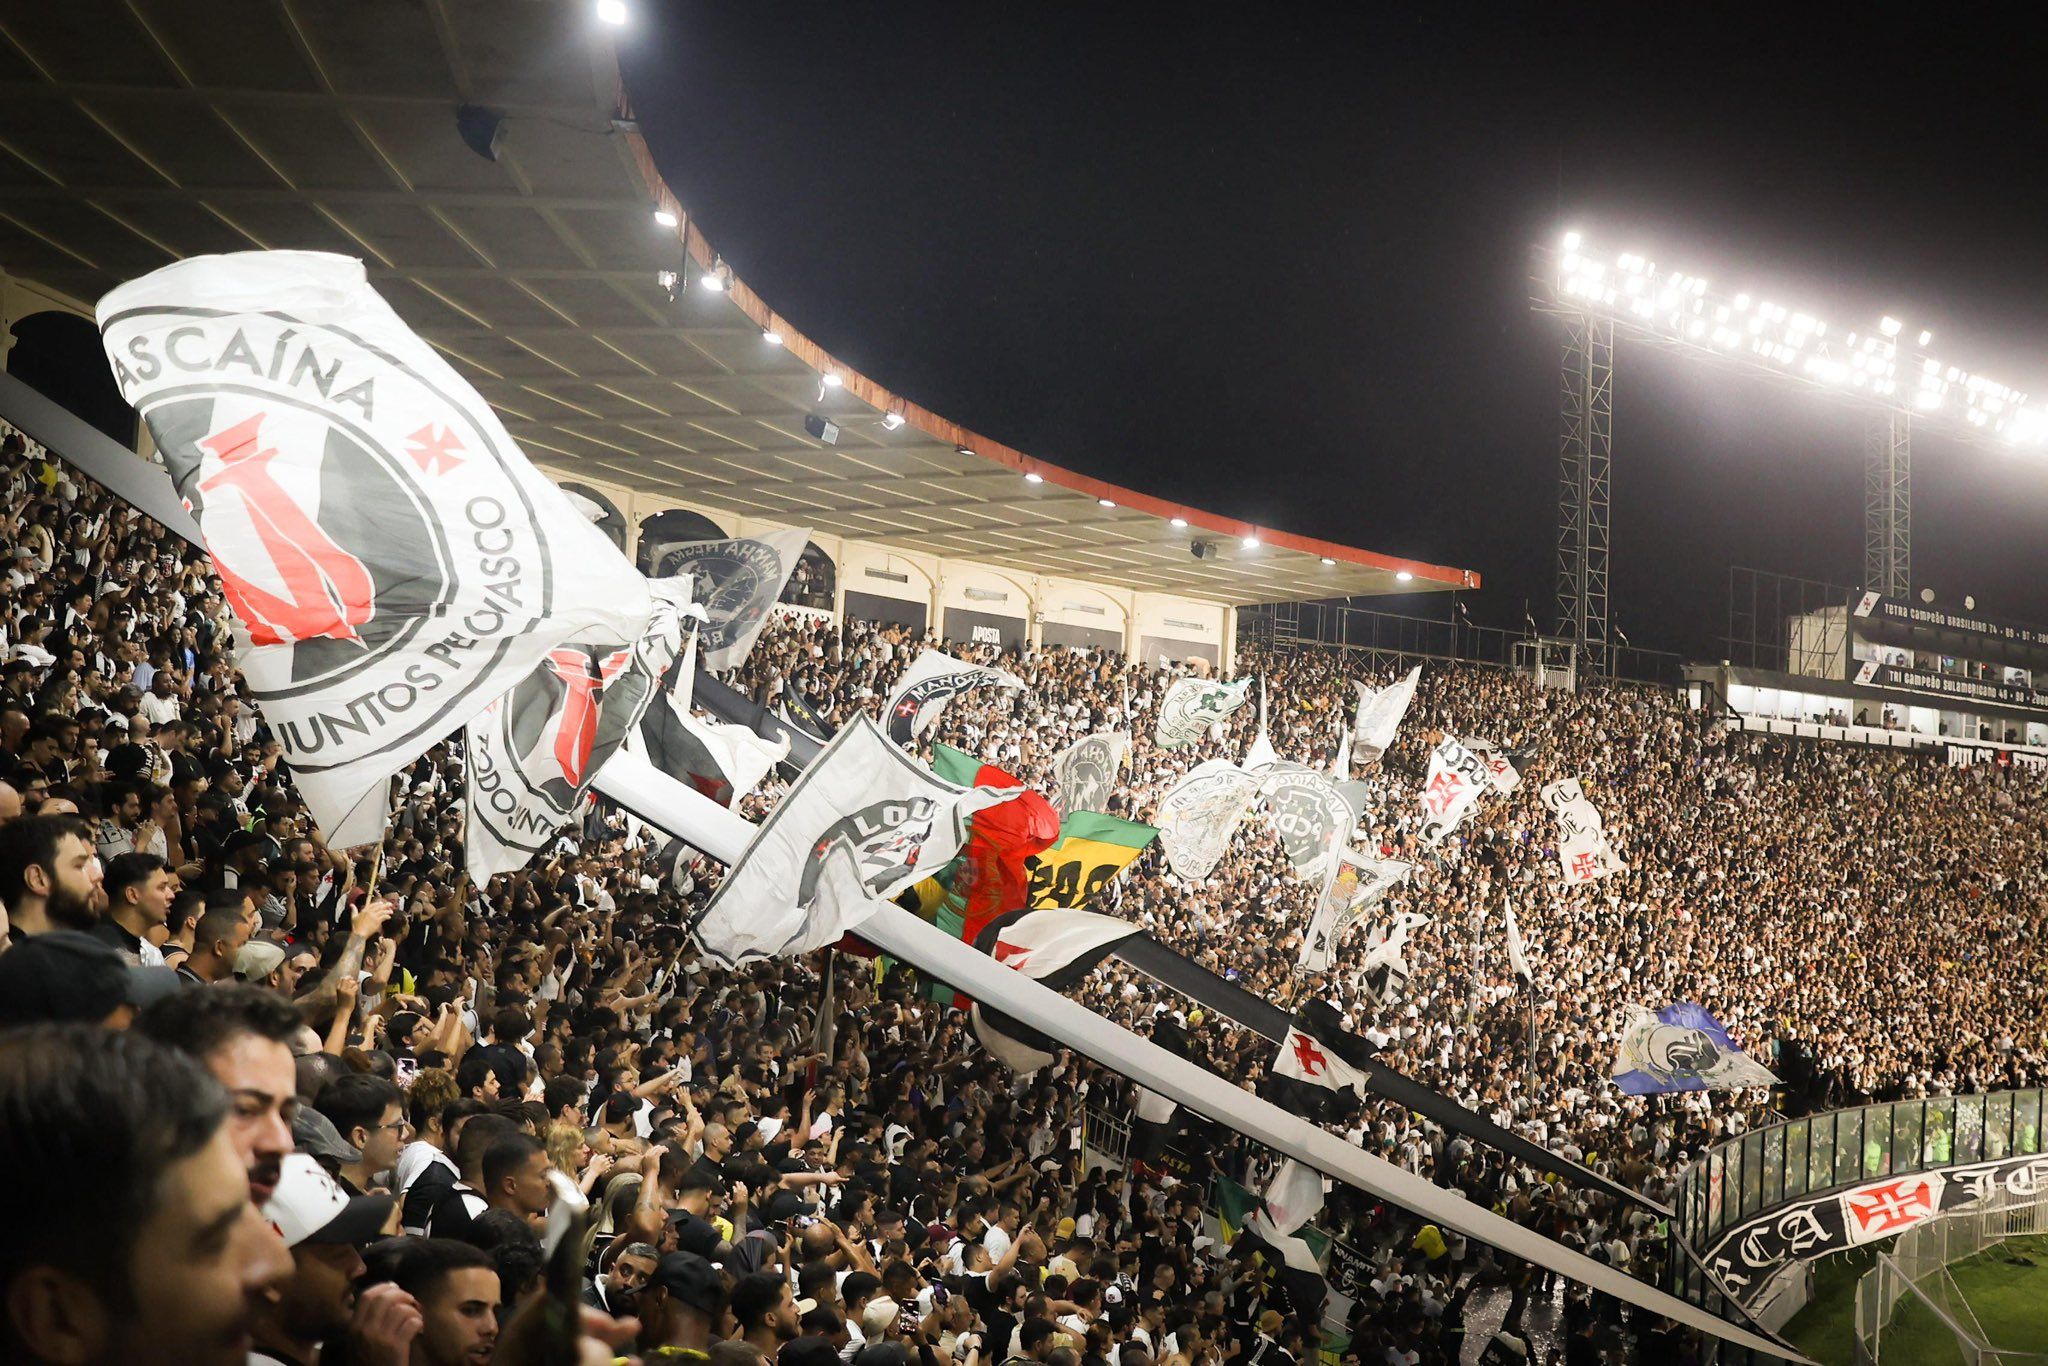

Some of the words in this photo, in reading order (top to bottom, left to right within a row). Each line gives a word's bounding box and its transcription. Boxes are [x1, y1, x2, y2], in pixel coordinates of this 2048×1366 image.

[277, 664, 443, 755] JUNTOS
[465, 496, 523, 614] VASCO
[972, 625, 1000, 645] APOSTA
